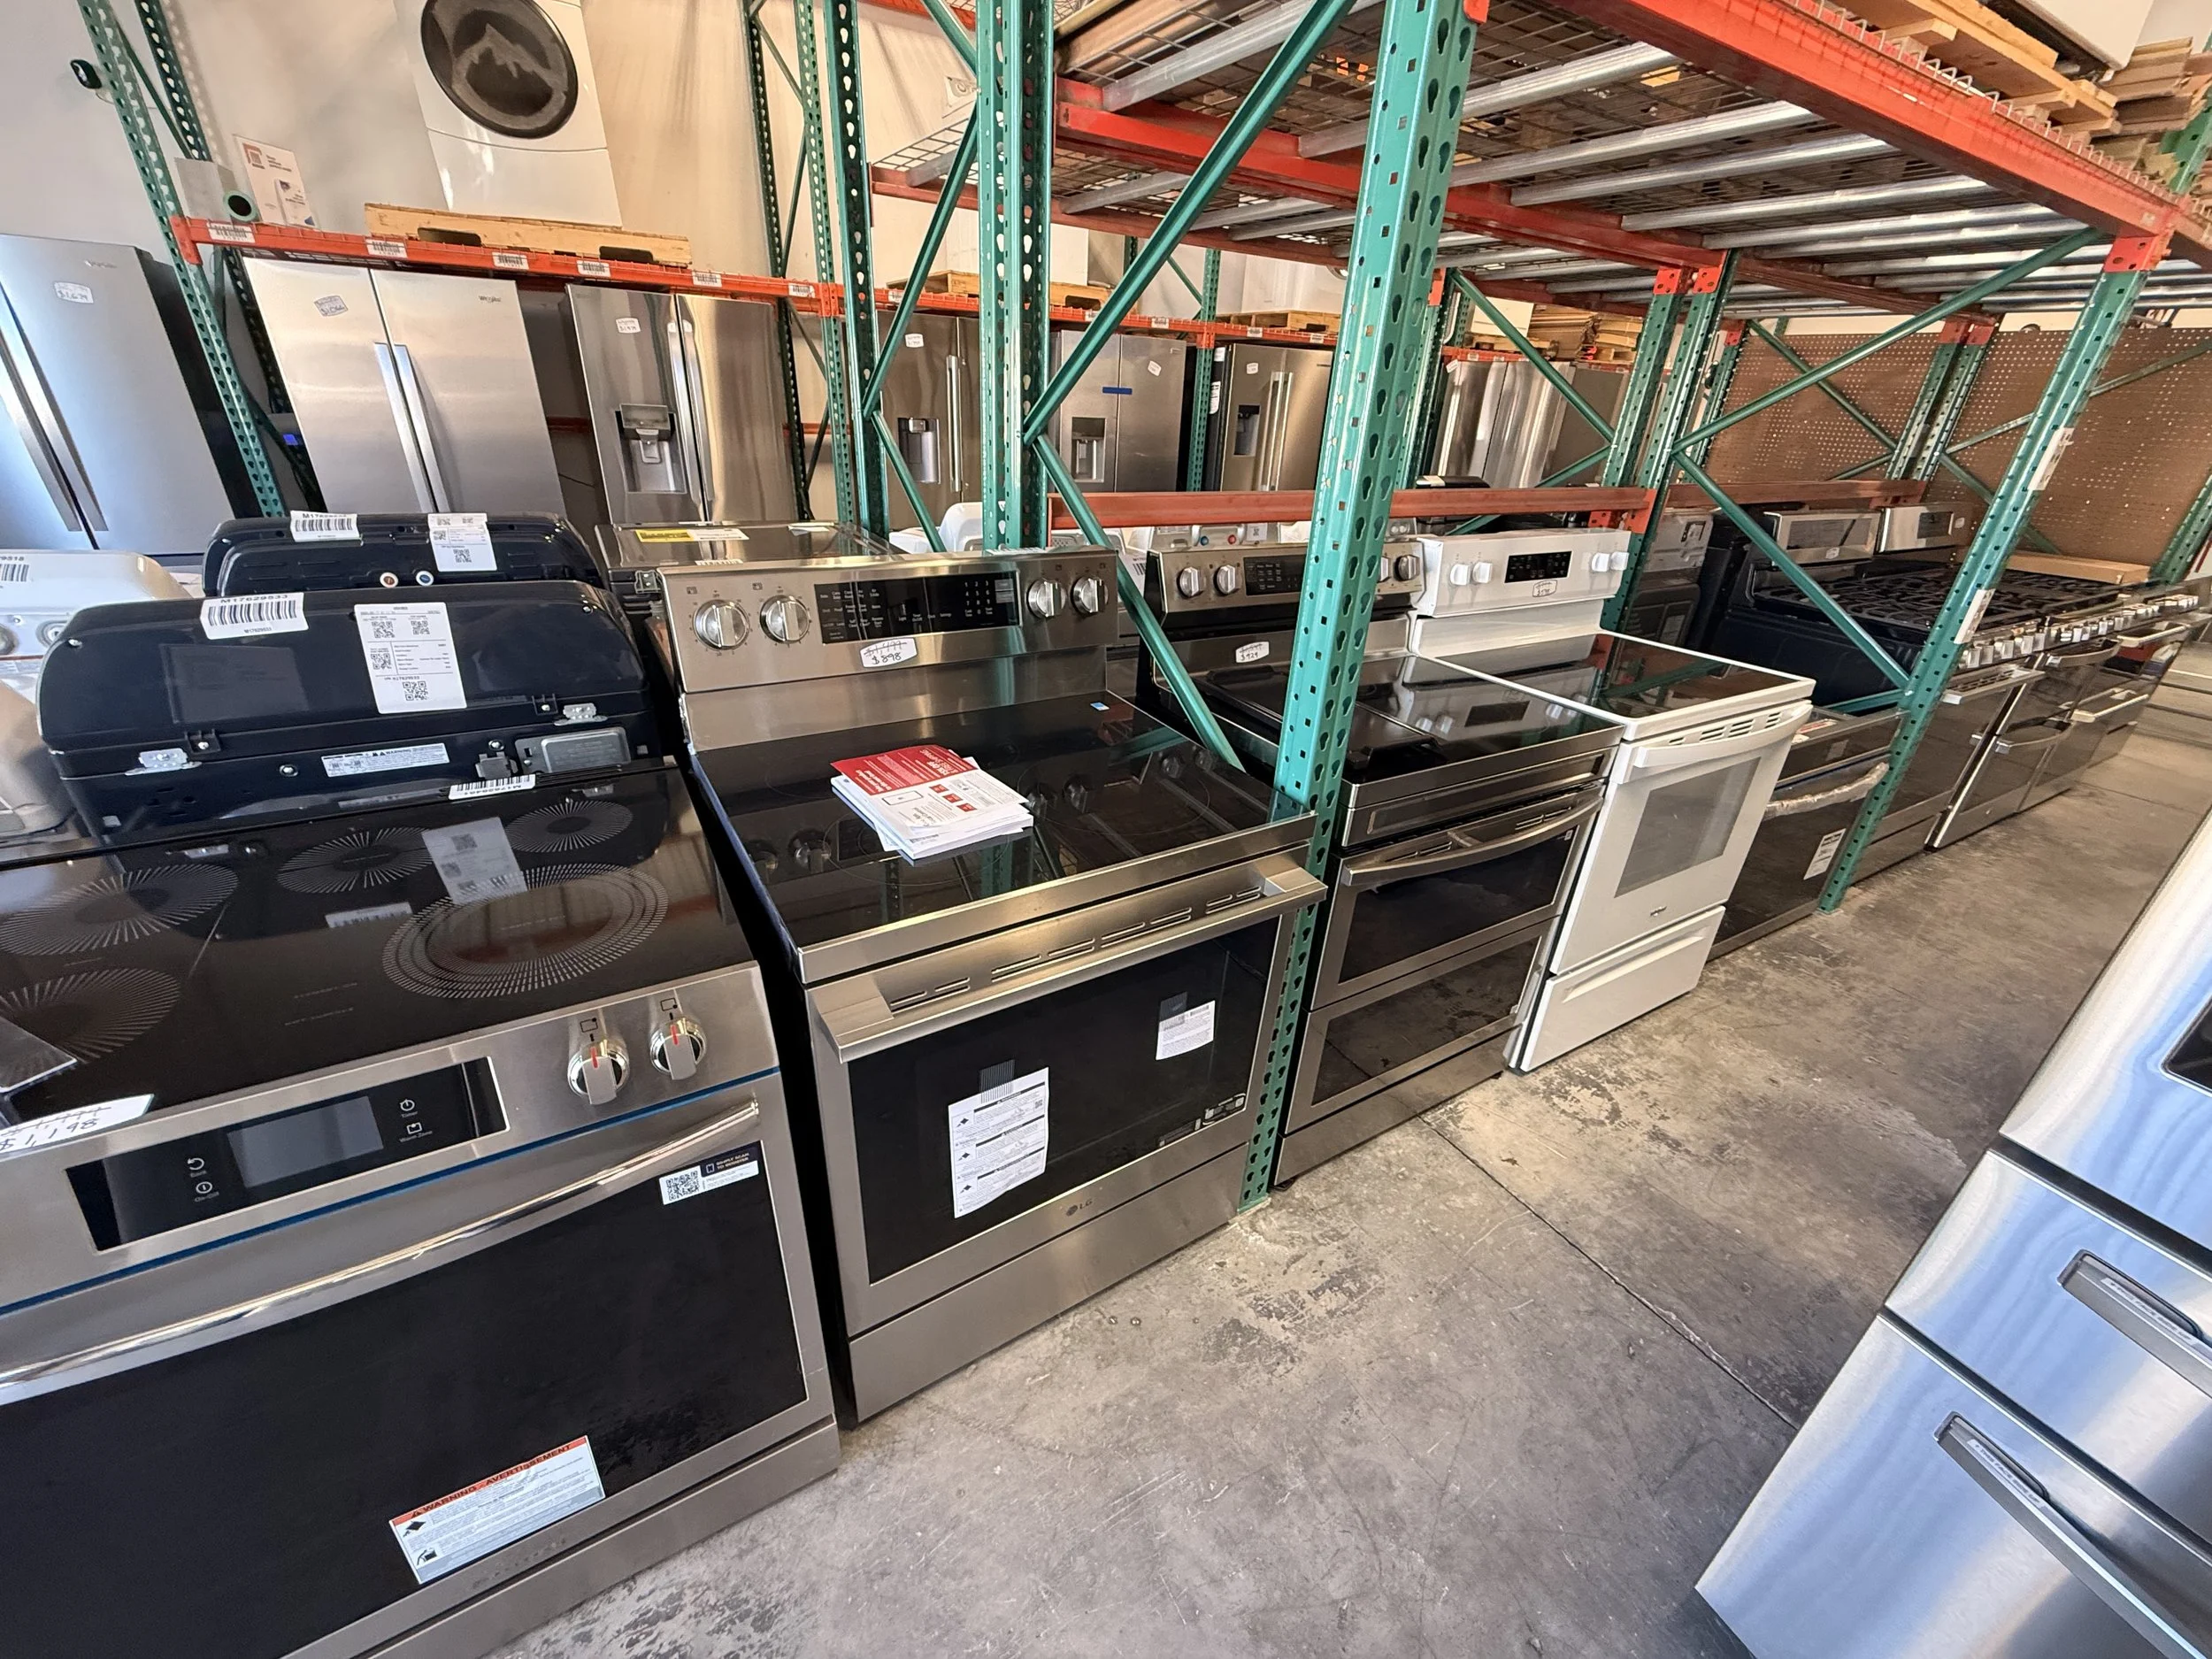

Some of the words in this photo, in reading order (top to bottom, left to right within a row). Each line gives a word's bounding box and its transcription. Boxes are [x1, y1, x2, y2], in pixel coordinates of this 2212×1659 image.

[220, 595, 288, 603] M17629533
[872, 652, 901, 664] $898
[1079, 1198, 1093, 1210] LG
[422, 1486, 477, 1513] WARNING
[486, 1444, 572, 1486] AVERTISSEMENT
